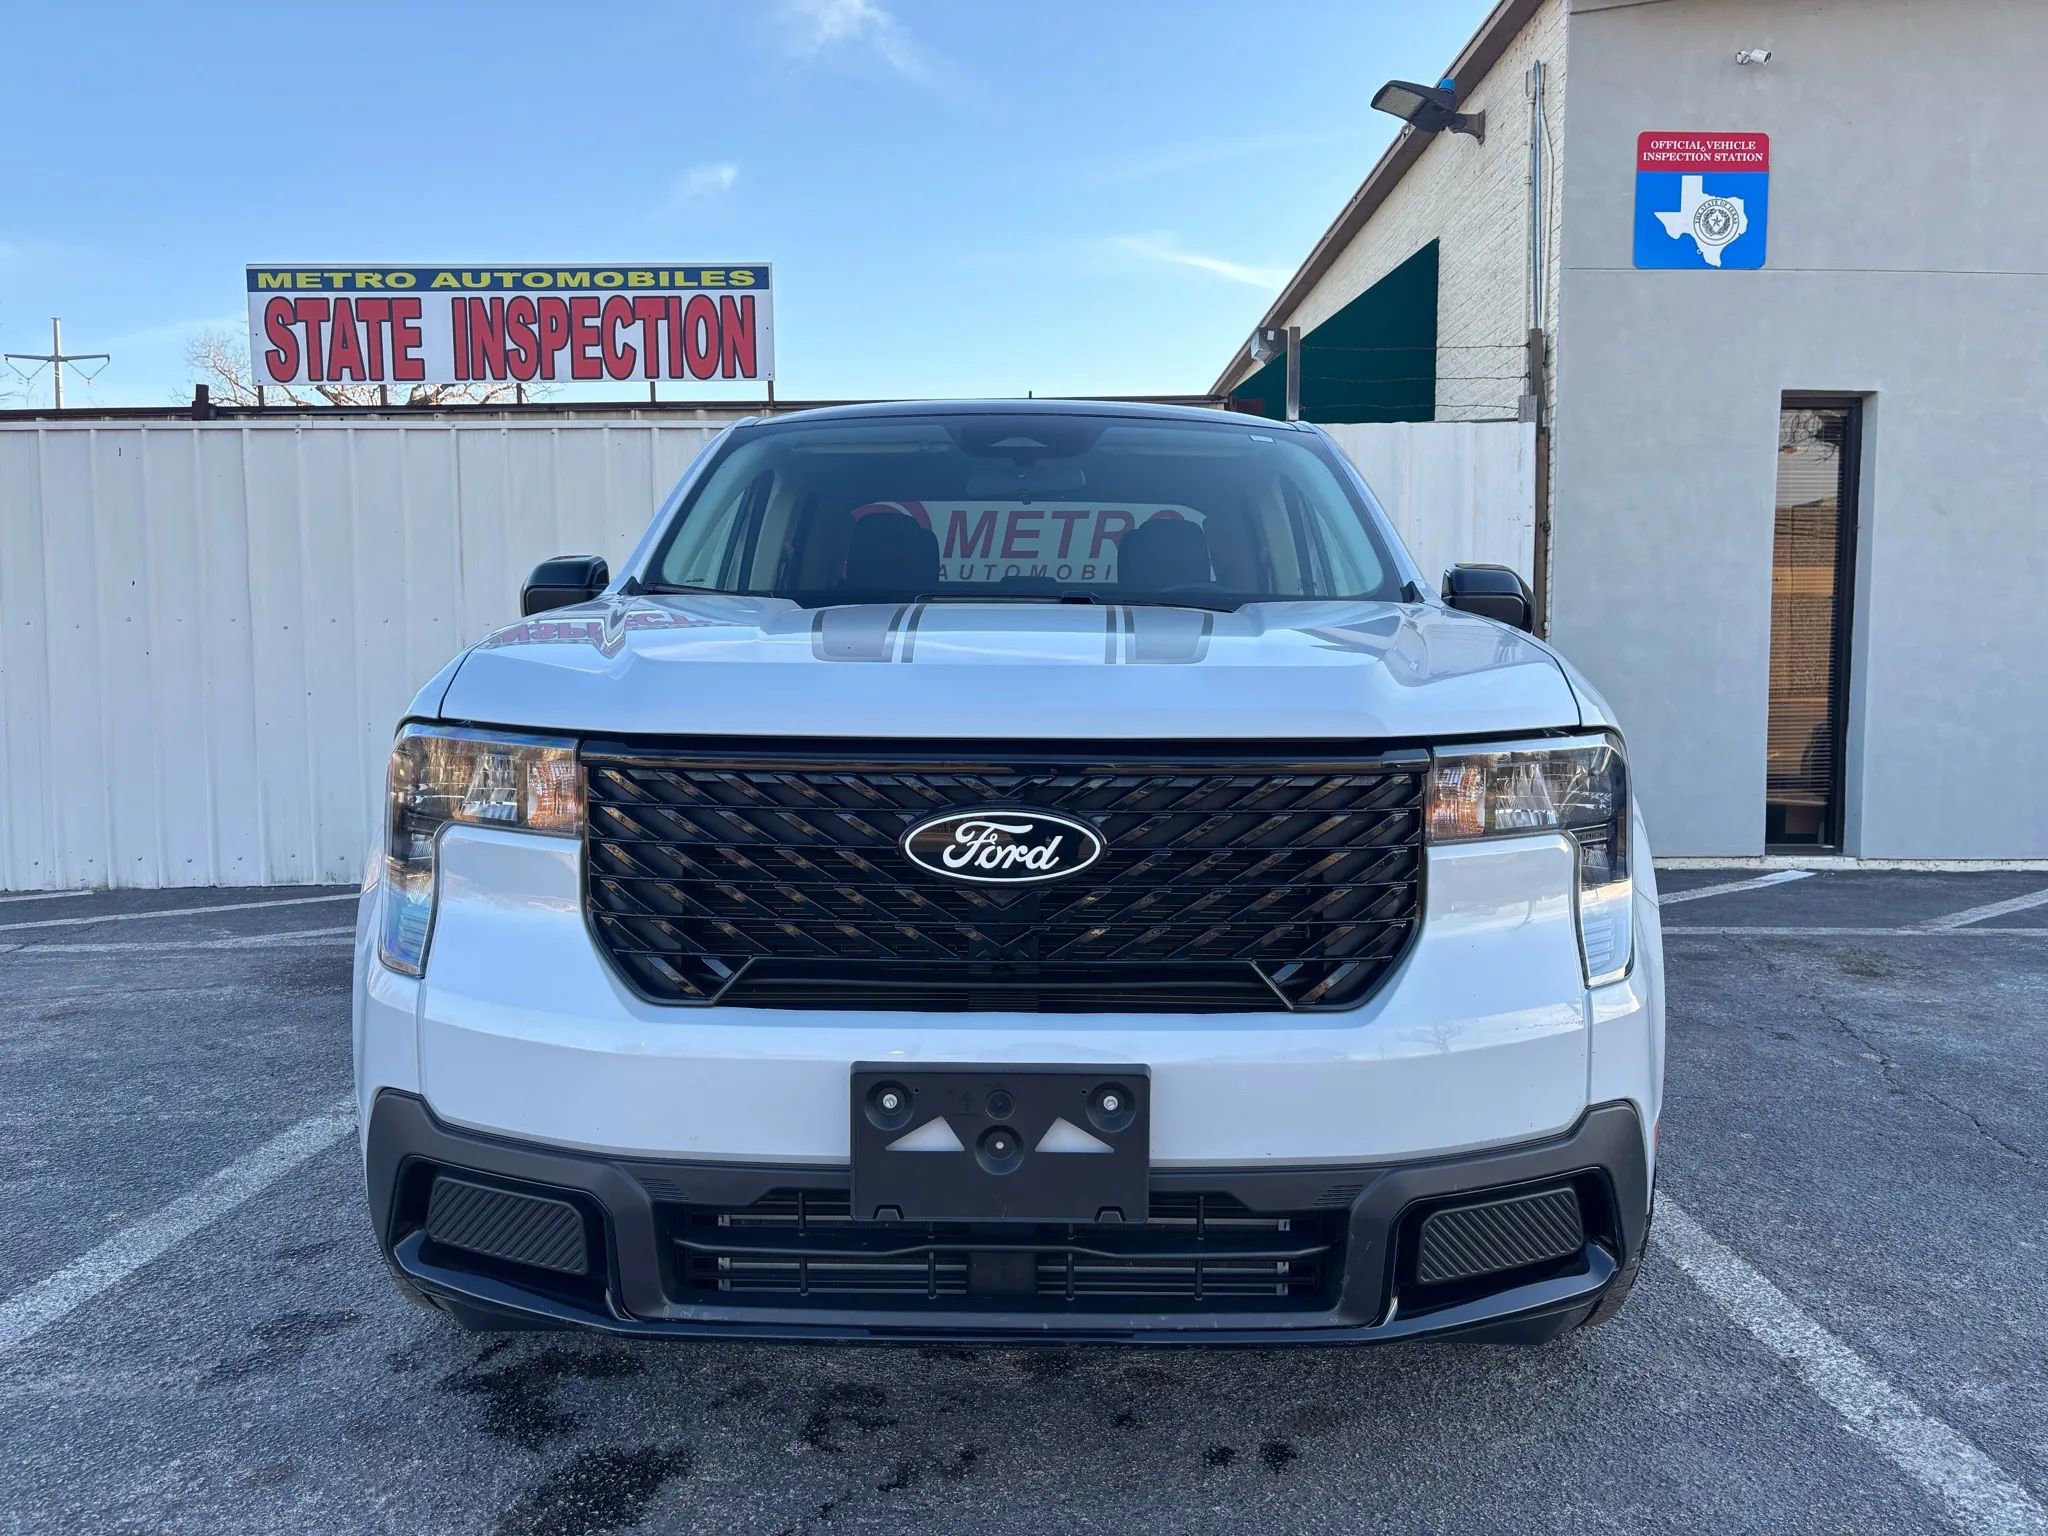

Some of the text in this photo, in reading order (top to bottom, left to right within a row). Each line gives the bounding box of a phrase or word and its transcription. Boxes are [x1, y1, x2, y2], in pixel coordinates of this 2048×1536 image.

[1650, 140, 1756, 150] OFFICIAL VEHICLE
[1643, 152, 1763, 161] INSPECTION STATION
[1700, 200, 1718, 212] STATE
[257, 270, 756, 289] METRO AUTOMOBILES
[264, 294, 757, 382] STATE INSPECTION
[943, 510, 1185, 559] METR
[942, 821, 1063, 870] Ford
